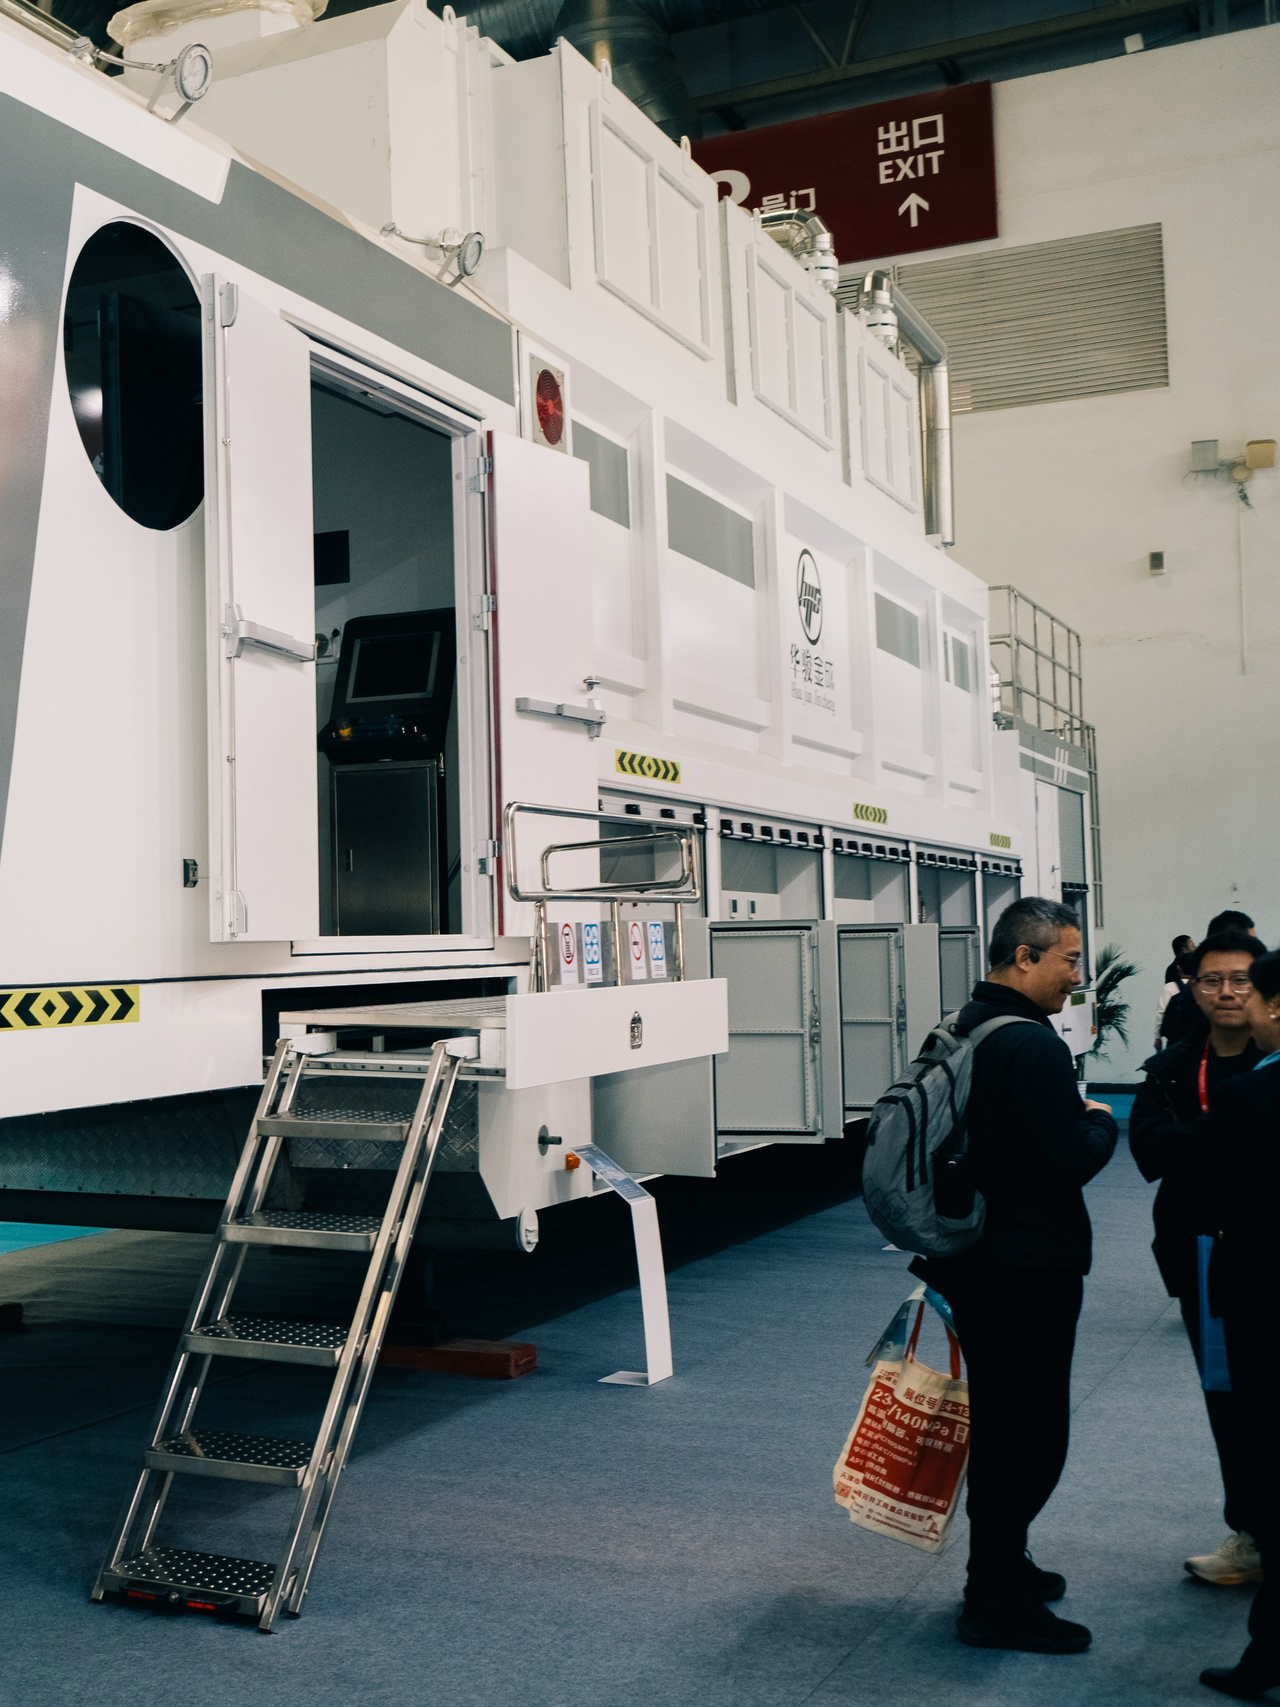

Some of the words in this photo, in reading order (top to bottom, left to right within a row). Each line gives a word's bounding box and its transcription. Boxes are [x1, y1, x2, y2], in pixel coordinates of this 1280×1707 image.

[877, 113, 944, 155] 出口
[878, 150, 945, 184] EXIT
[903, 1387, 938, 1410] 展位号
